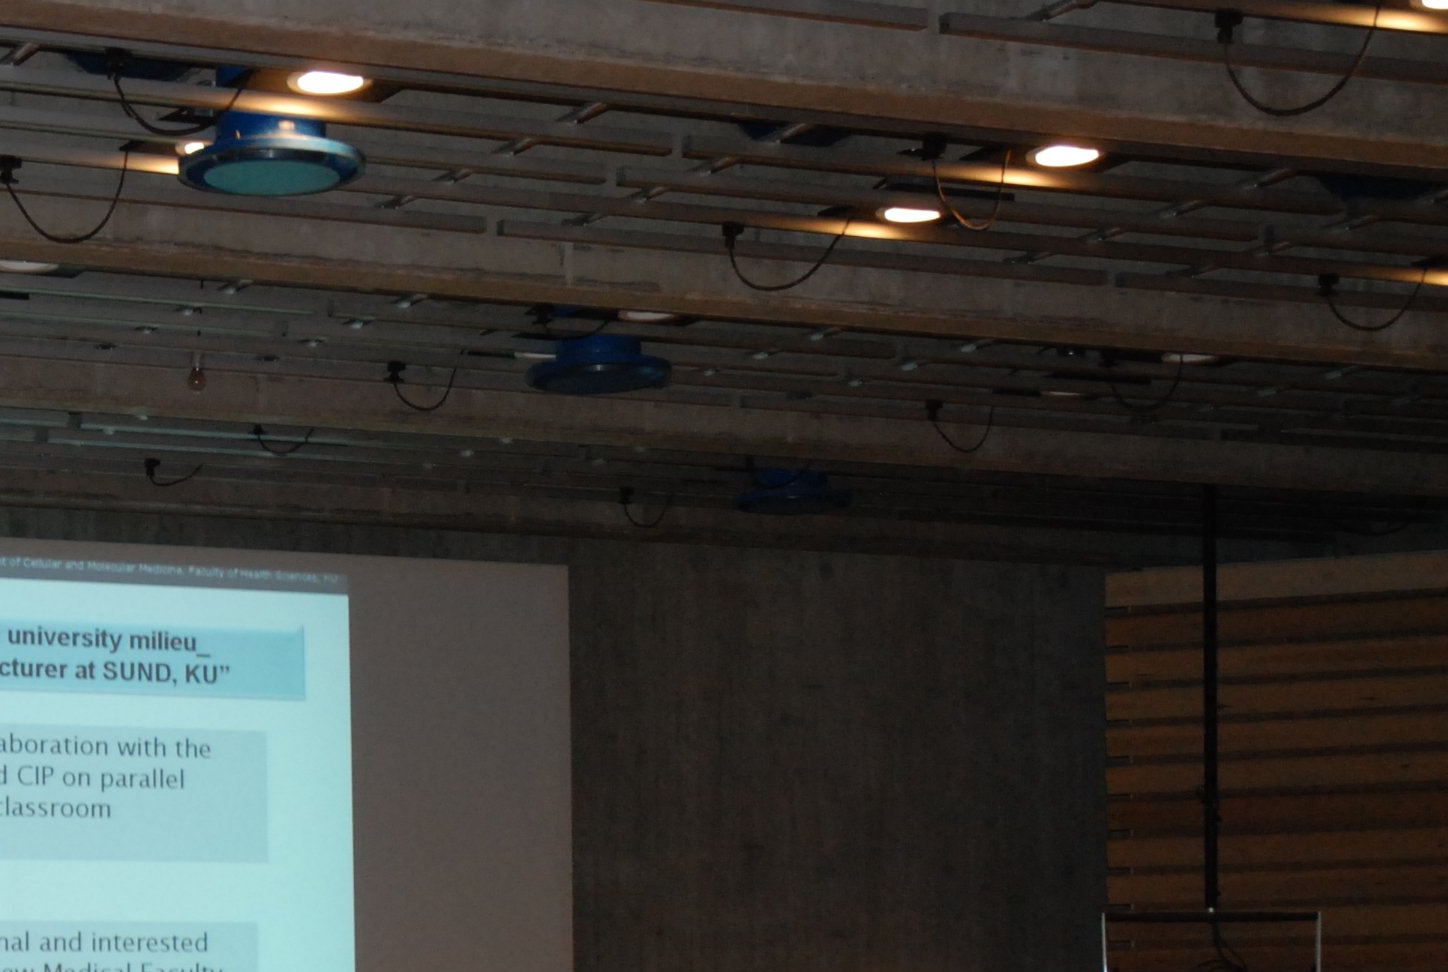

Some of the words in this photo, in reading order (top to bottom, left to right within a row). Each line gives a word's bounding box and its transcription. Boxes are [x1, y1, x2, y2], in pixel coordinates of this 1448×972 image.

[9, 557, 21, 568] of
[23, 558, 61, 570] Cellular
[65, 560, 84, 571] and
[88, 561, 137, 573] Molecular
[188, 565, 224, 579] Faculty
[227, 568, 238, 578] of
[8, 625, 122, 653] university
[75, 661, 96, 680] at
[103, 661, 178, 687] SUND,
[185, 663, 230, 685] KU”
[117, 736, 167, 758] with
[175, 738, 211, 759] the
[17, 764, 54, 787] CIP
[62, 770, 91, 788] on
[101, 768, 185, 793] parallel
[39, 930, 82, 952] and
[91, 931, 208, 953] interested
